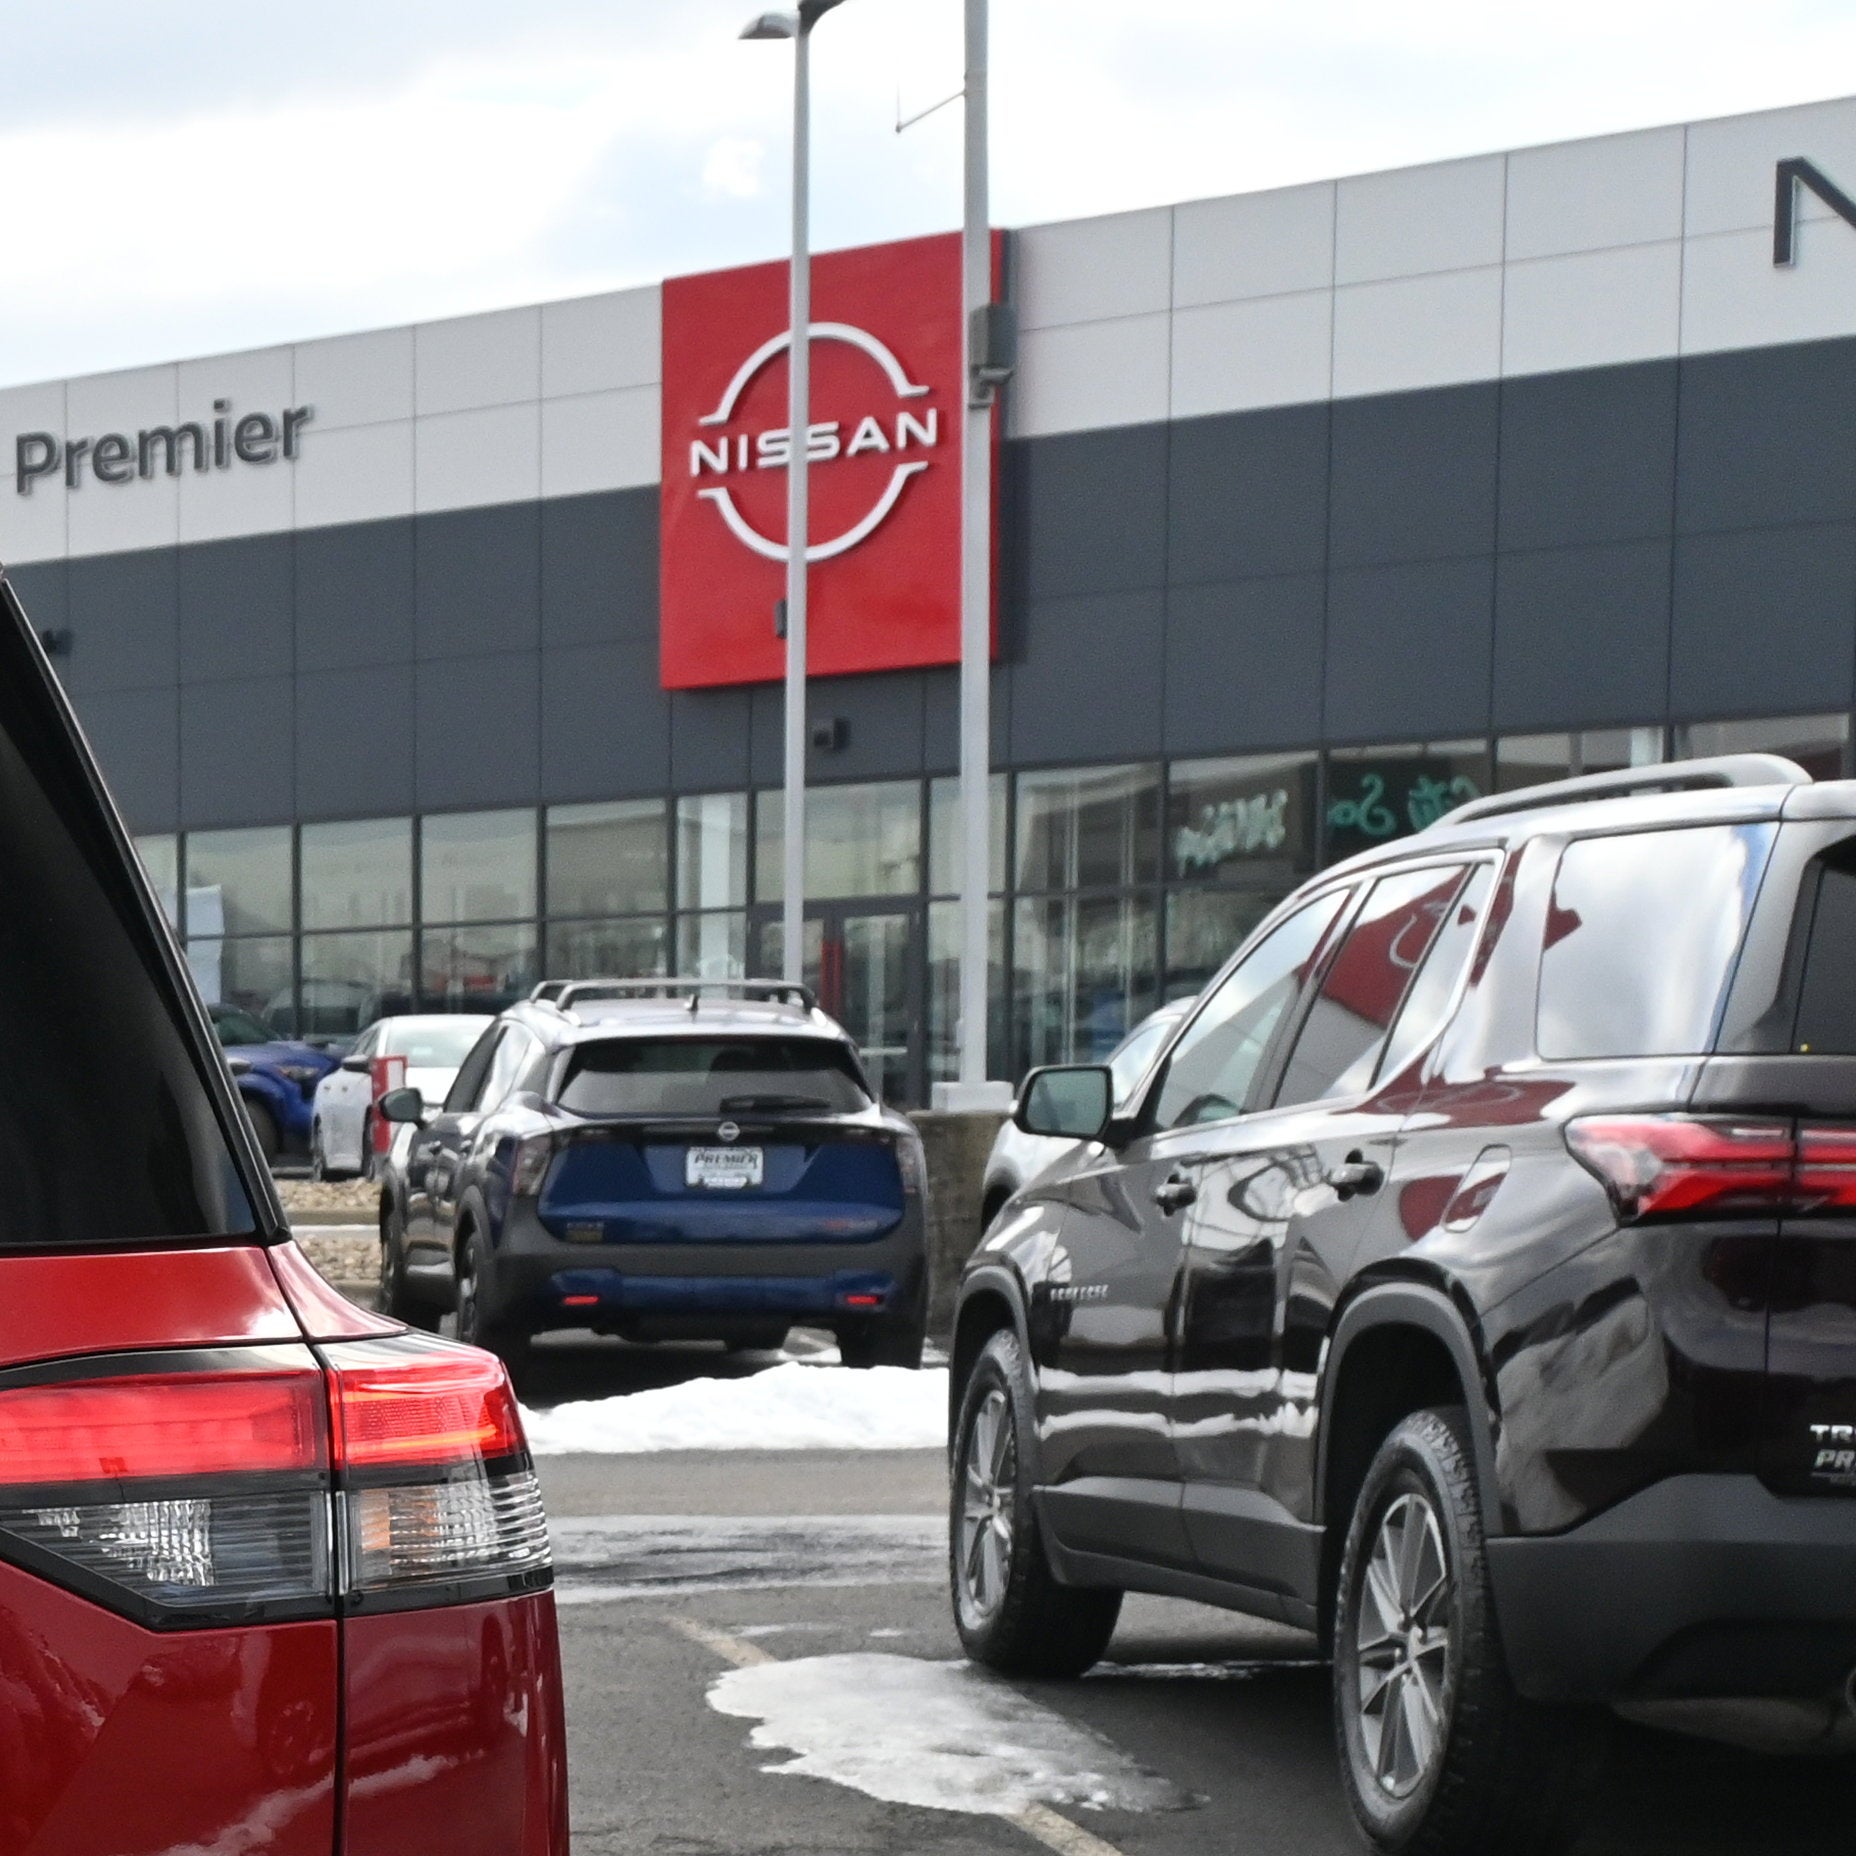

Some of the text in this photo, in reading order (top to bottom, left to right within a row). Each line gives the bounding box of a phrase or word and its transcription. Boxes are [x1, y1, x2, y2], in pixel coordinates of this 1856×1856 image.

[15, 398, 315, 496] Premier
[690, 407, 937, 478] NISSAN
[1809, 1424, 1856, 1441] TR
[1814, 1449, 1856, 1470] PR
